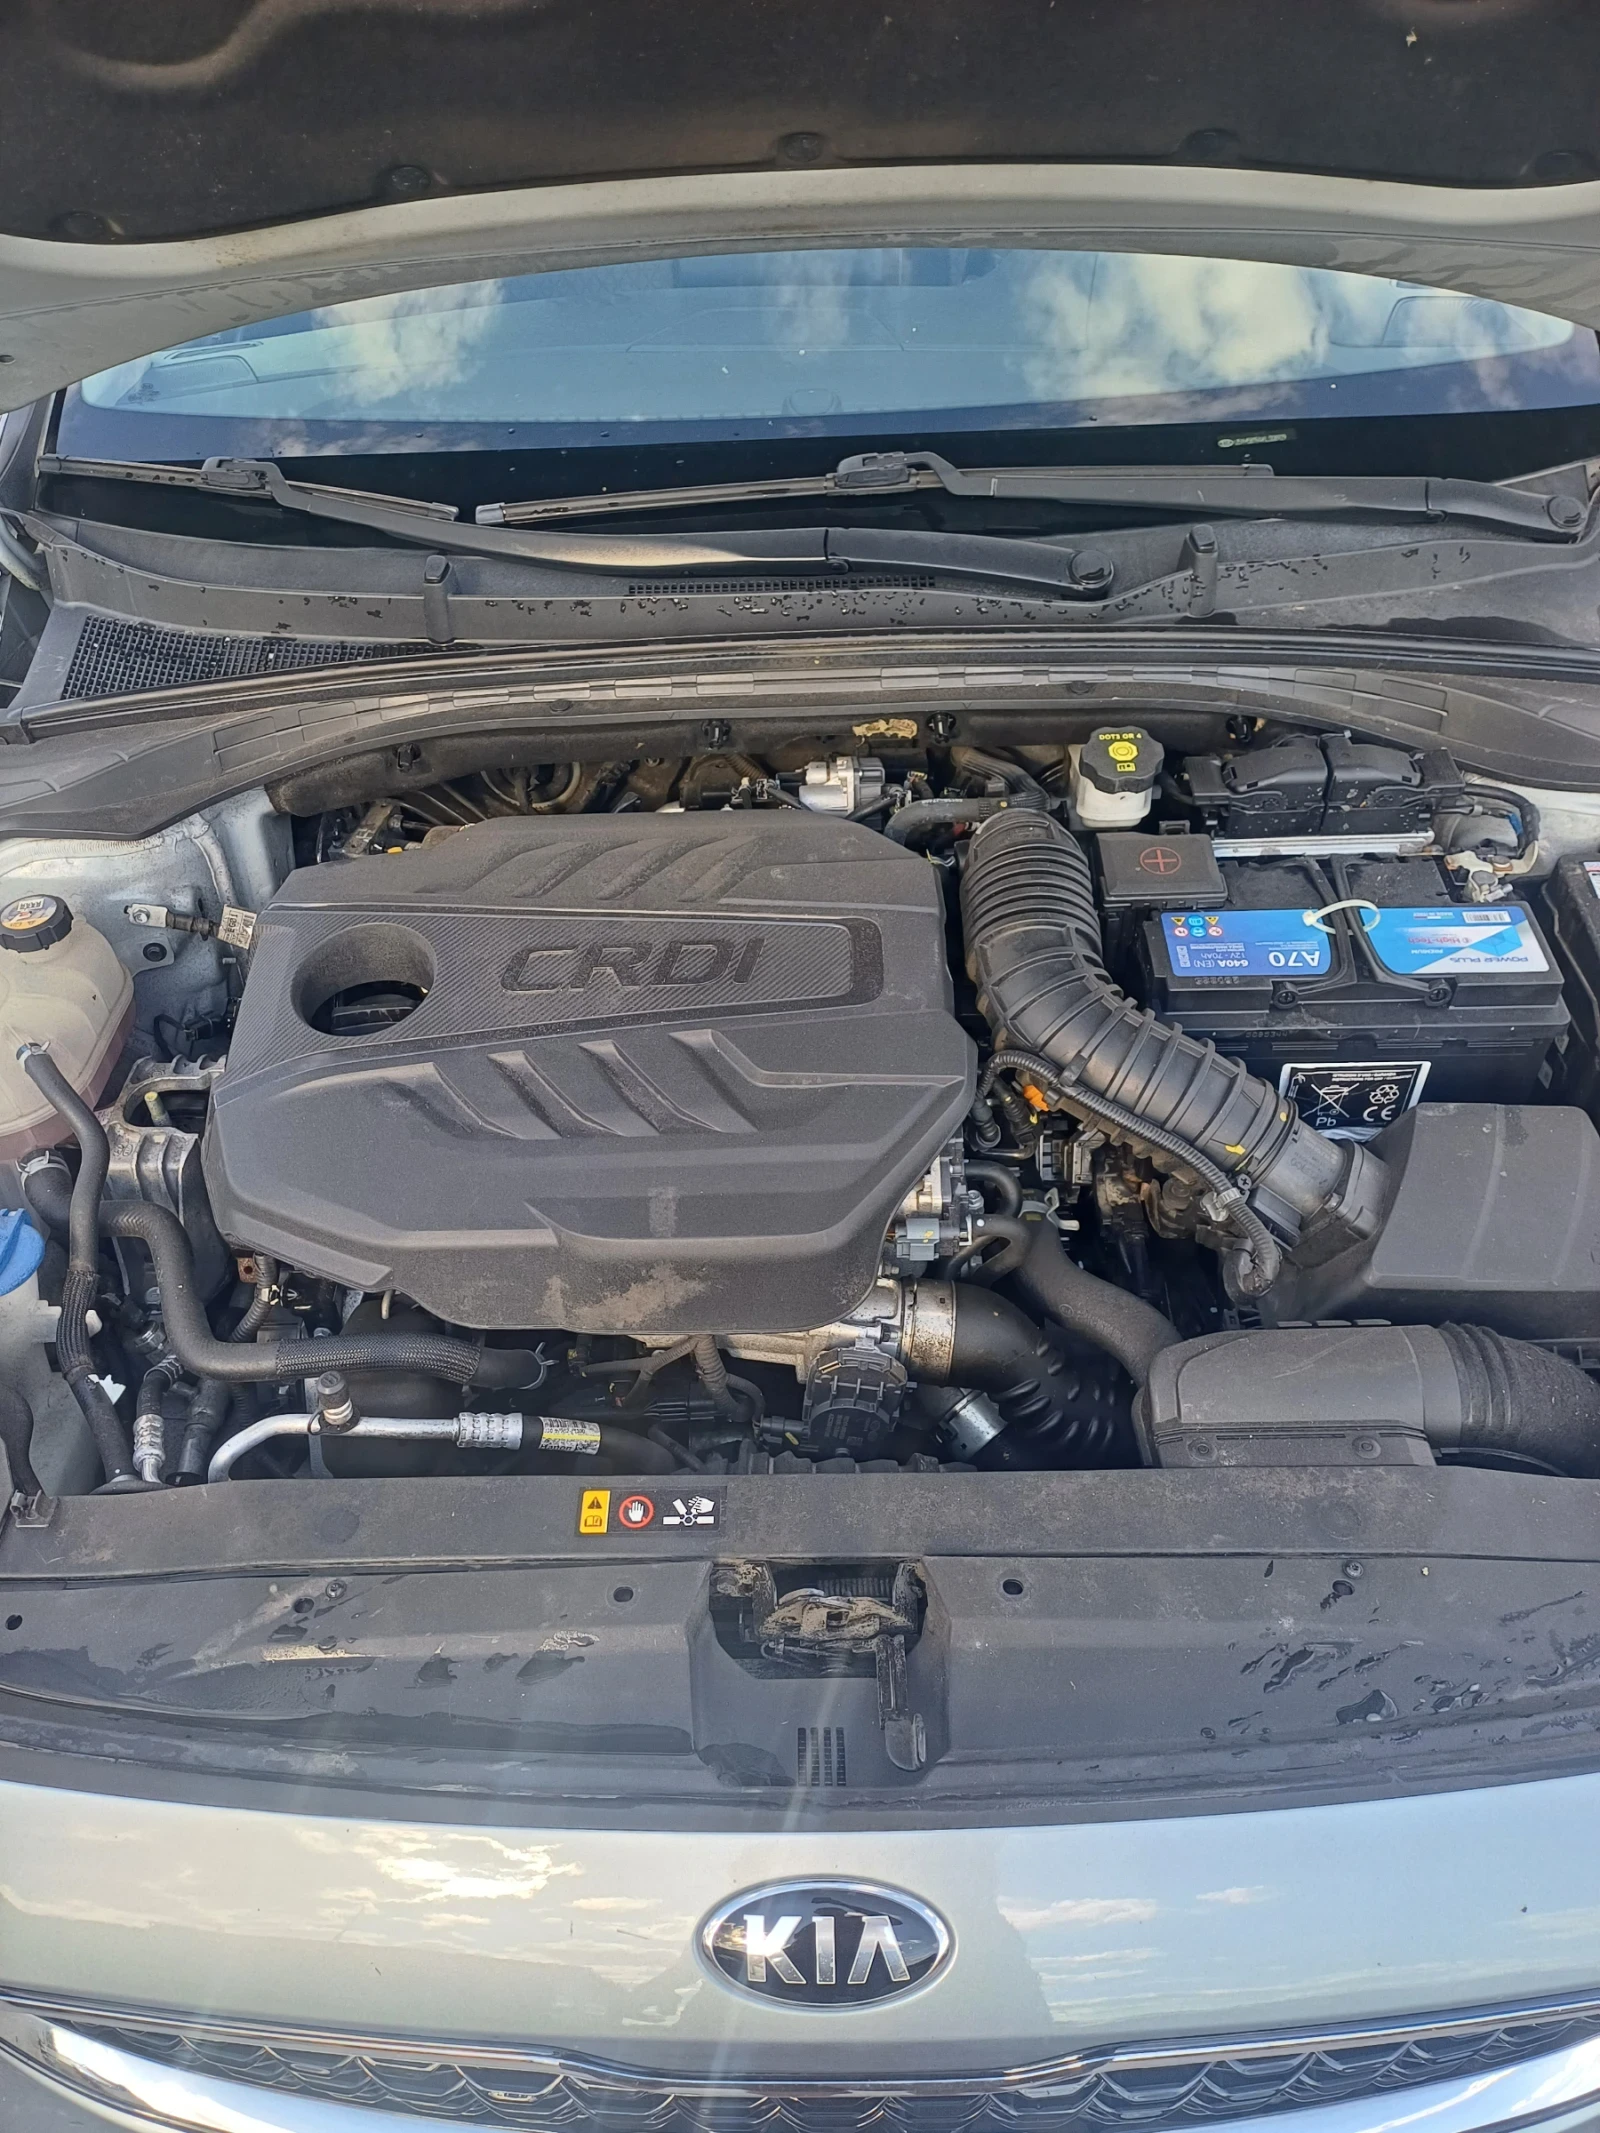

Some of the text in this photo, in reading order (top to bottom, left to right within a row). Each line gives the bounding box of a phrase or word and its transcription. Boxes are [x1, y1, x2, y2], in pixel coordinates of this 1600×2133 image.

[1099, 733, 1121, 741] DOT3
[1122, 732, 1135, 740] OR
[500, 938, 767, 992] CRDI
[1193, 959, 1249, 968] 640A (EN)
[1268, 950, 1321, 968] A70
[1315, 1117, 1337, 1127] Pb
[743, 1914, 911, 1986] KIA
